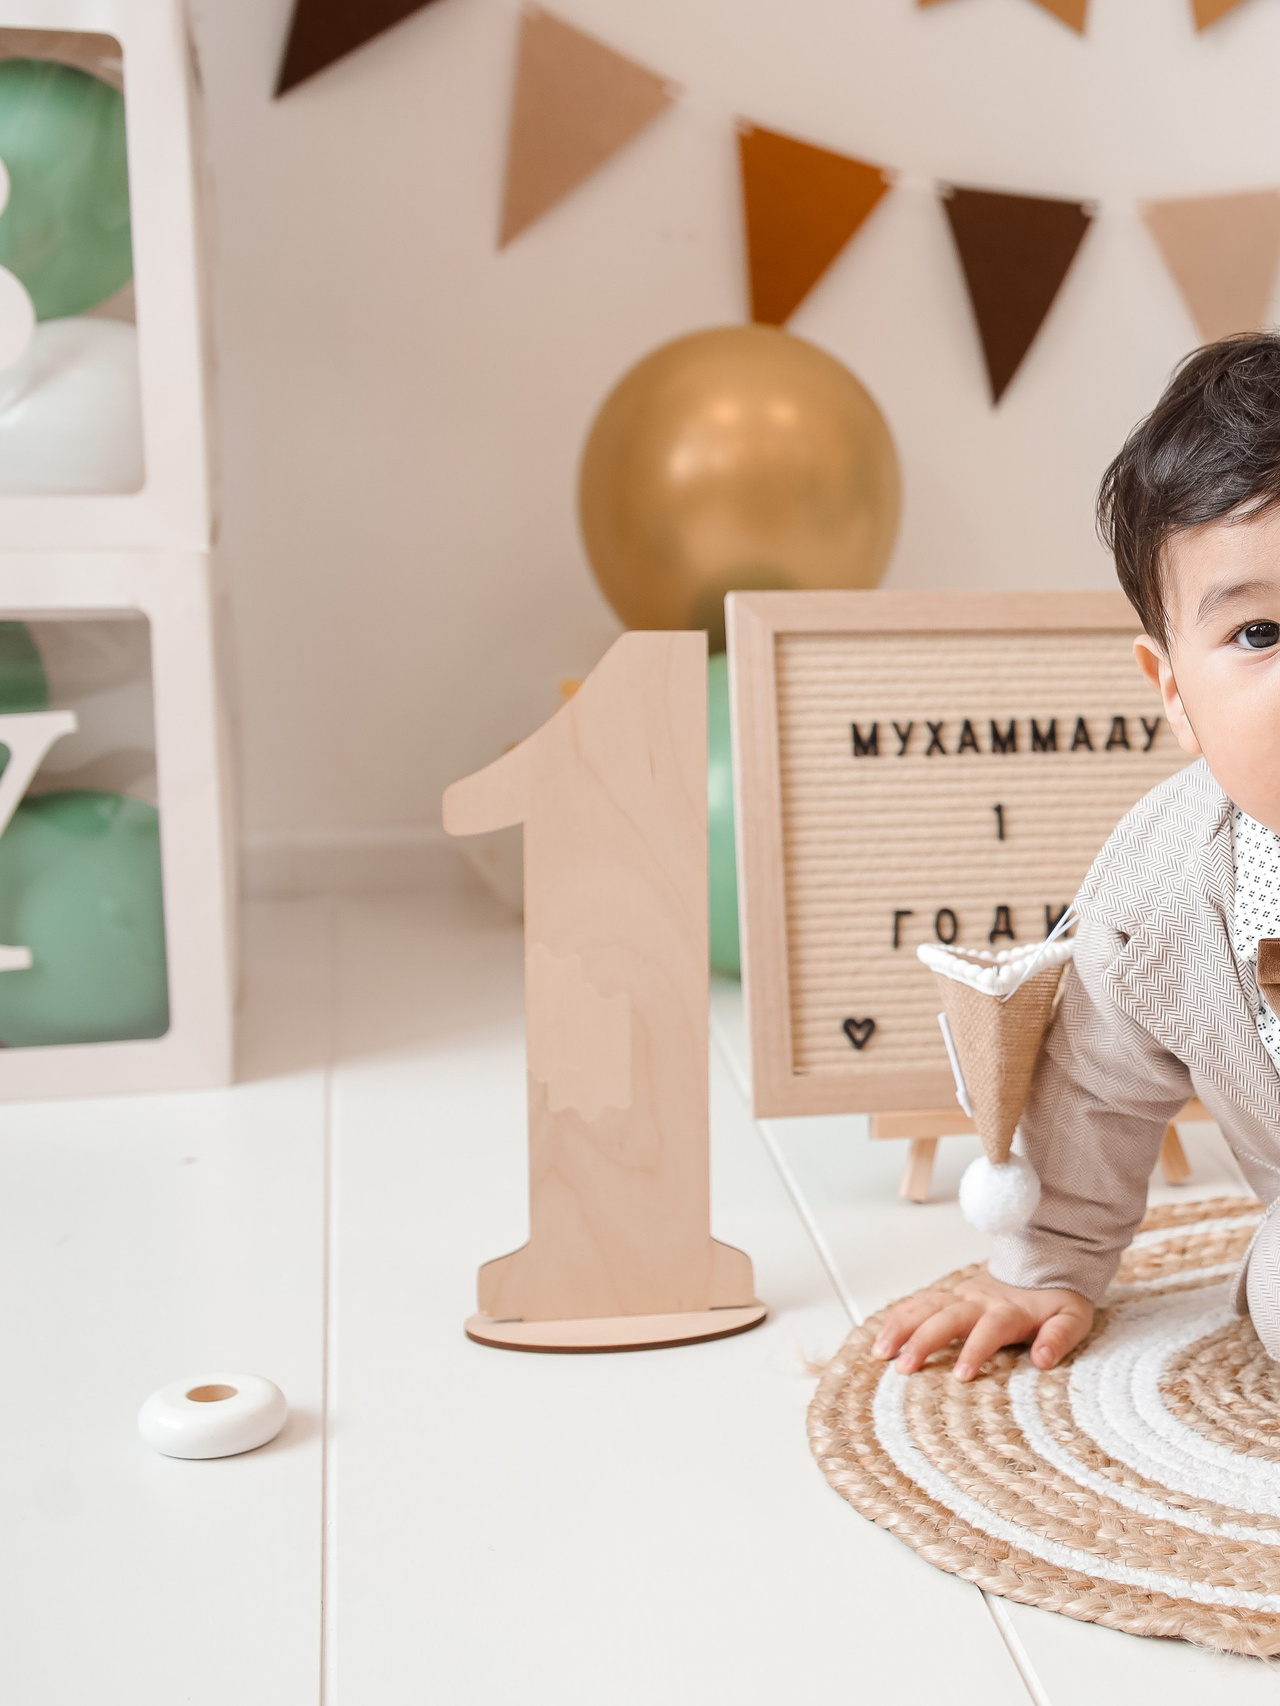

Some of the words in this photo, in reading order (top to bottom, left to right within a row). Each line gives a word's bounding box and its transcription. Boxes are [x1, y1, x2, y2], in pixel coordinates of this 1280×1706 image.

[851, 716, 1160, 757] МУХАММАДУ
[992, 803, 1006, 841] 1
[891, 904, 1071, 948] ГОДИ
